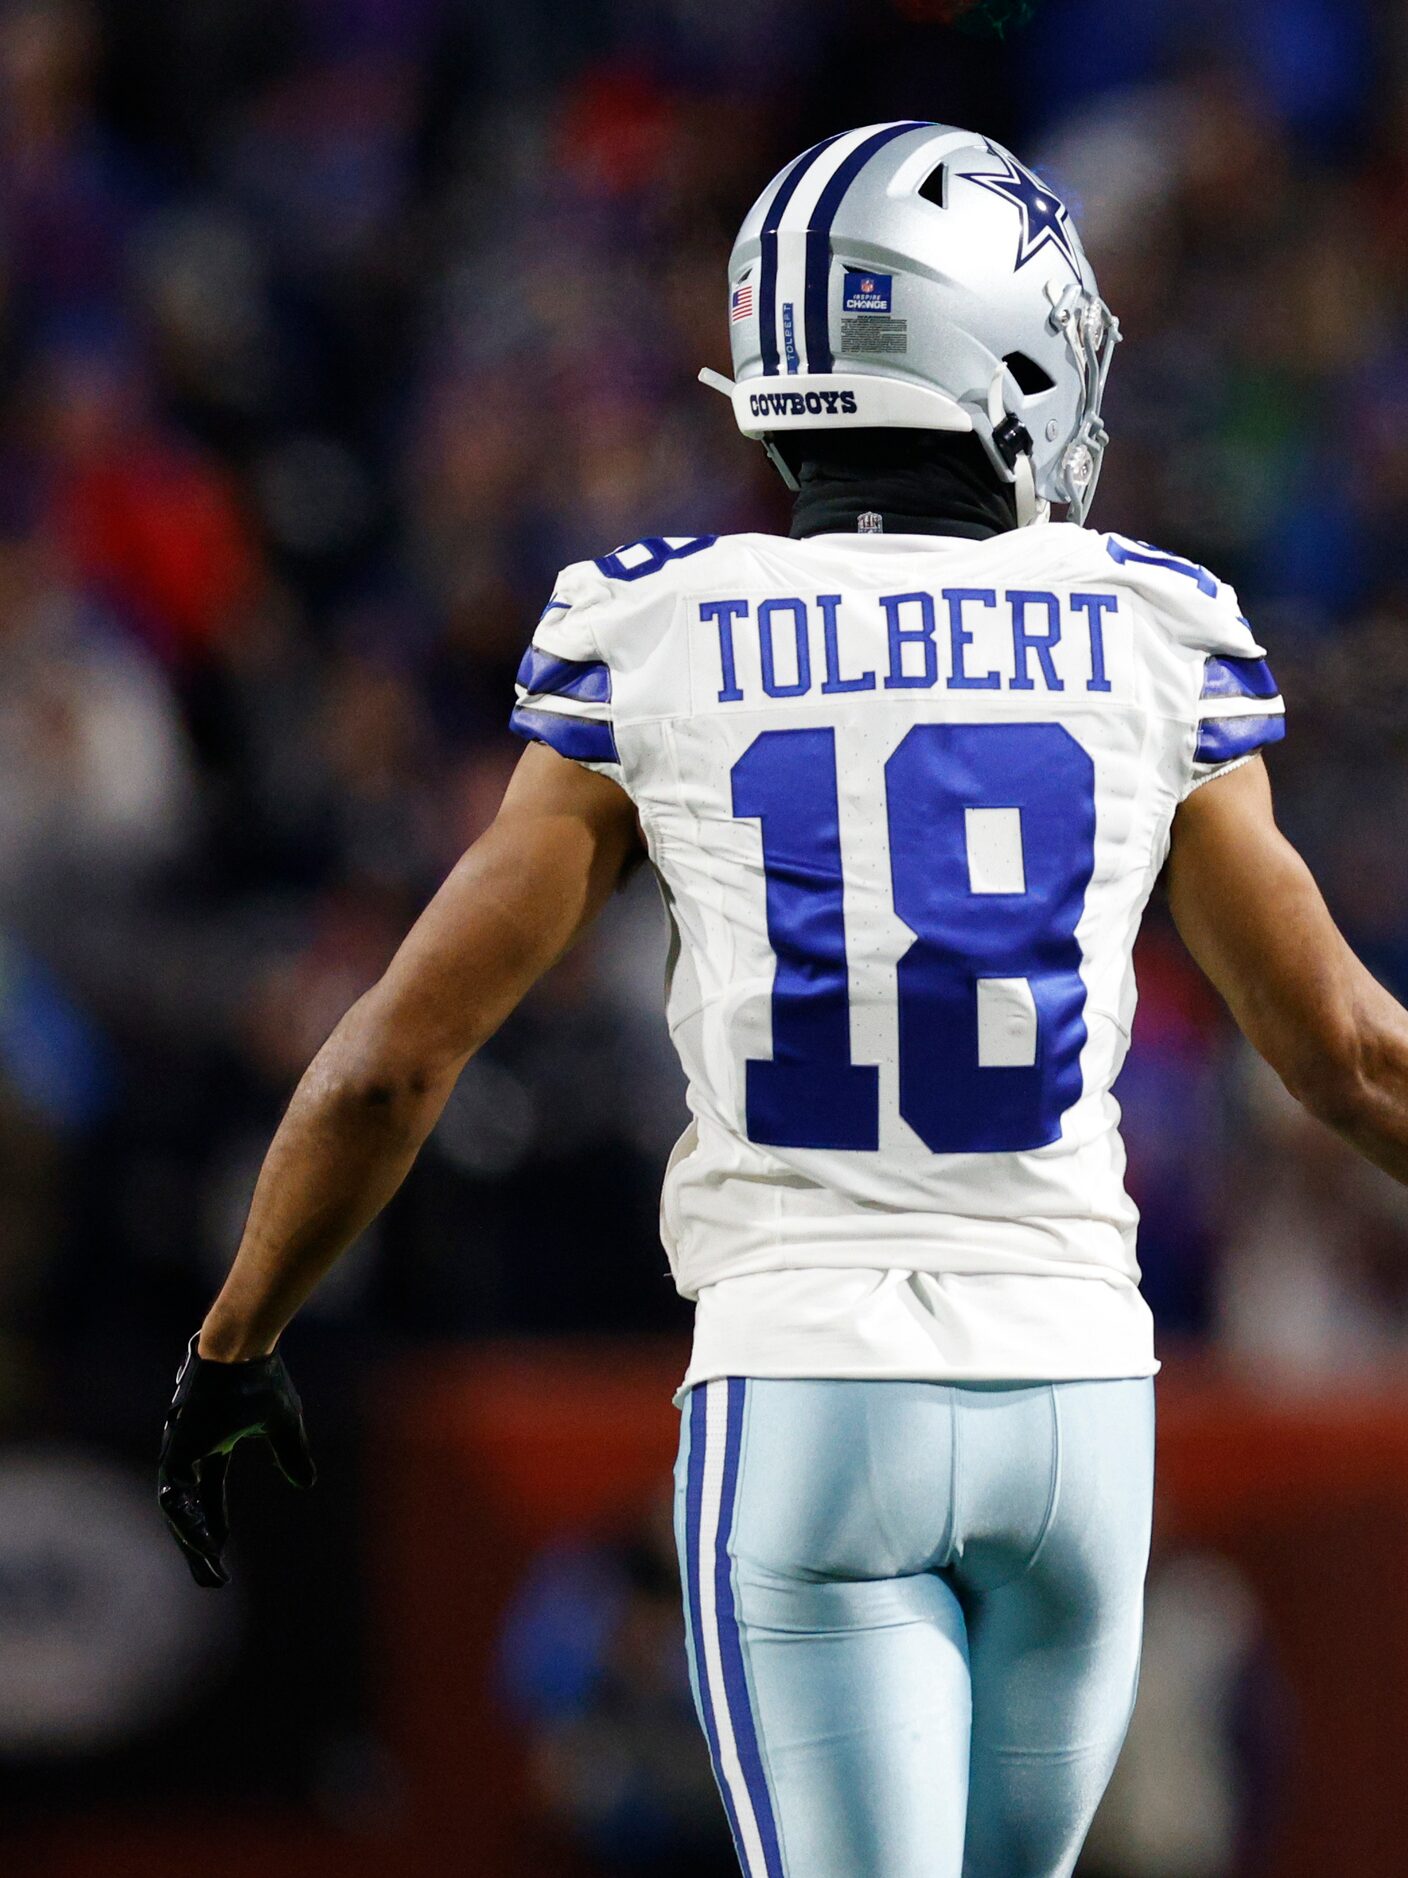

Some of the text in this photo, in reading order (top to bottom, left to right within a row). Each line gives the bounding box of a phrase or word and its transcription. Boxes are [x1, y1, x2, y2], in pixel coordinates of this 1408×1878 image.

[846, 299, 888, 309] CHANGE
[750, 391, 857, 416] COWBOYS
[698, 587, 1119, 703] TOLBERT
[730, 722, 1096, 1155] 18
